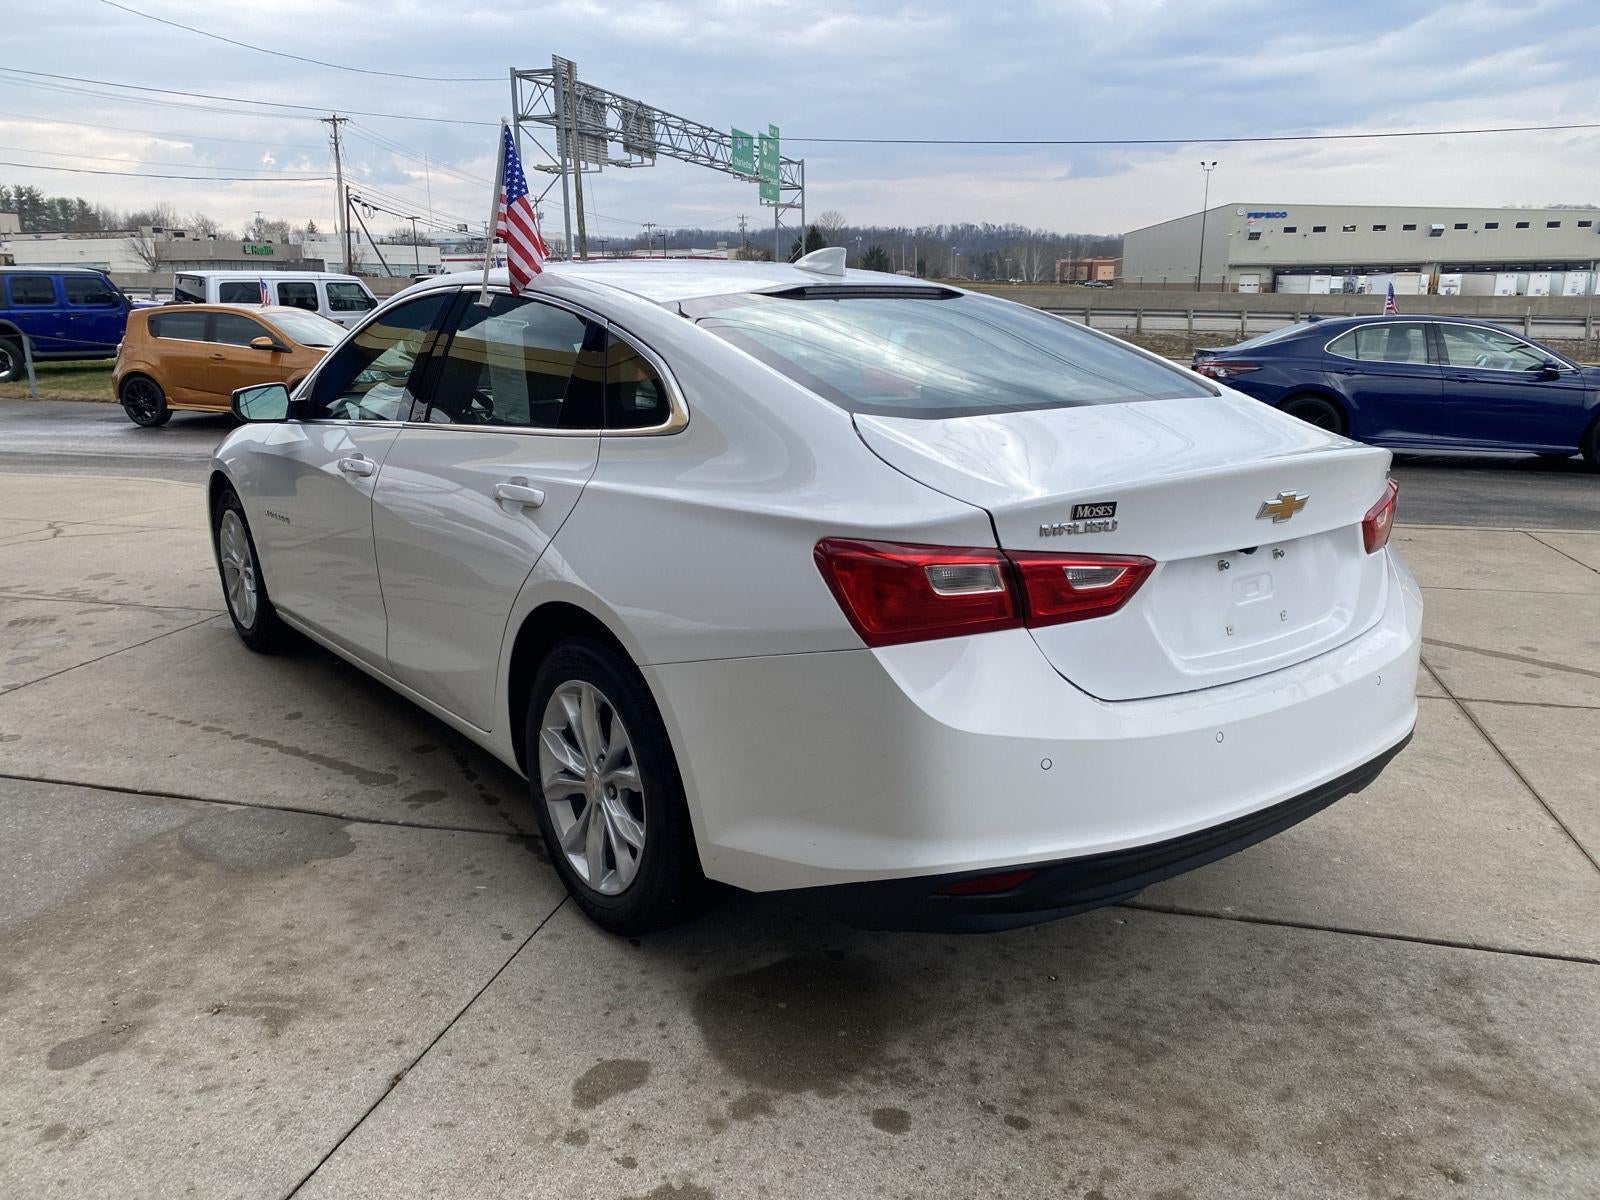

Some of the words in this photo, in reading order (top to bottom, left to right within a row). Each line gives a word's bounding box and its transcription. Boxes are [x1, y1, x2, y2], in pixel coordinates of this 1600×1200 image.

[252, 244, 273, 255] Health
[1076, 505, 1113, 518] MOSES
[1040, 520, 1118, 537] MALIBU
